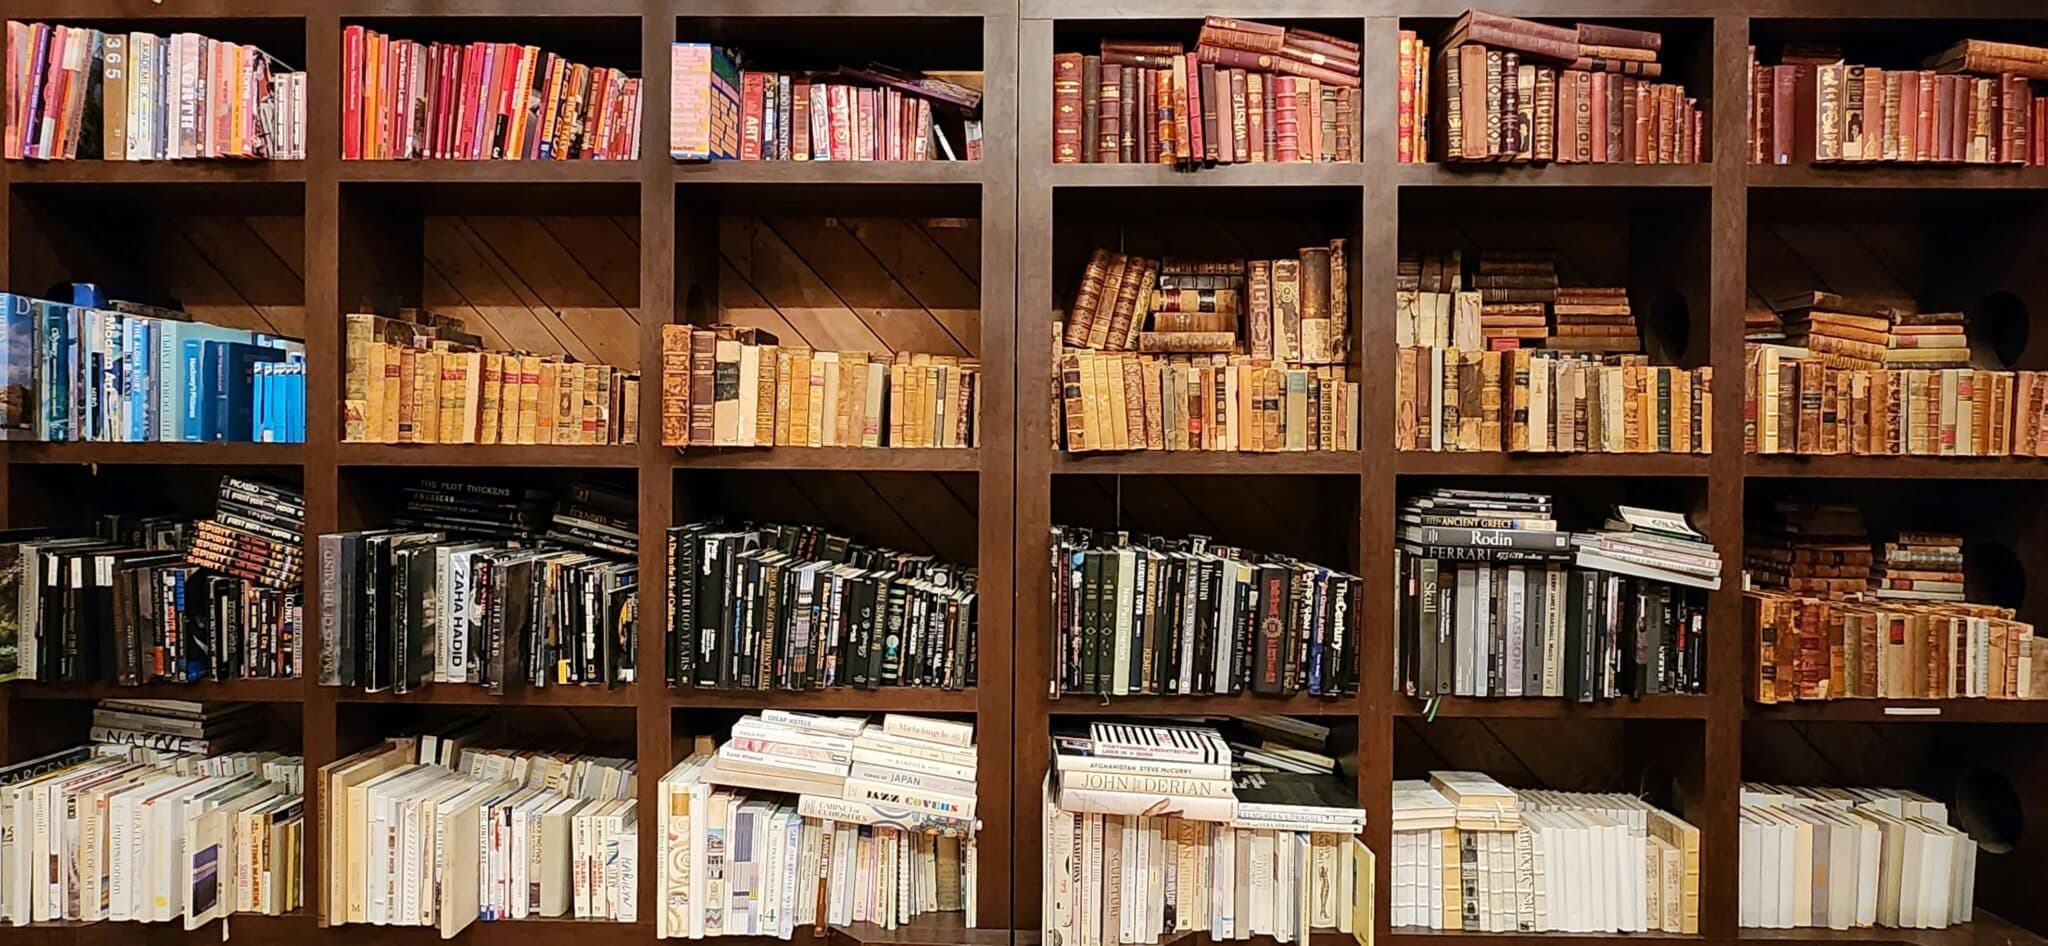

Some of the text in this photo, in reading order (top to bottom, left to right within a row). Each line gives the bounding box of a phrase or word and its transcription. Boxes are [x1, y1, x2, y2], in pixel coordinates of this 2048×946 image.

[1234, 93, 1247, 140] WHISTLE
[104, 317, 116, 370] Modern
[466, 484, 511, 498] THICKENS
[1441, 515, 1479, 527] ANCIENT
[668, 543, 677, 556] Day
[682, 533, 693, 576] VANITY
[1428, 547, 1492, 561] FERRARI
[1469, 530, 1513, 547] Rodin
[322, 550, 334, 585] MIND
[1199, 563, 1214, 601] Havana
[681, 579, 692, 607] FAIR
[1423, 581, 1437, 612] Skull
[323, 612, 334, 627] OF
[452, 569, 465, 668] ZAHA HADID
[491, 597, 501, 657] THIS LAND
[667, 598, 676, 632] California
[1118, 587, 1132, 661] New Paris Interiors
[1236, 616, 1246, 641] Medal
[1510, 590, 1523, 661] ELIASSON
[322, 628, 335, 674] IMAGES
[680, 633, 691, 671] YEARS
[766, 714, 788, 724] CHEAP
[889, 773, 922, 787] JAPAN
[1080, 773, 1212, 796] JOHN DERIAN
[1089, 762, 1136, 773] AFGHANISTAN
[1139, 766, 1160, 775] STEVE
[866, 789, 959, 813] JAZZ COVERS
[87, 816, 97, 855] HISTORY
[112, 824, 125, 895] Impressionism
[1073, 833, 1082, 884] HAMPTONS
[87, 873, 96, 891] ART
[1110, 851, 1120, 921] SCULPTURE
